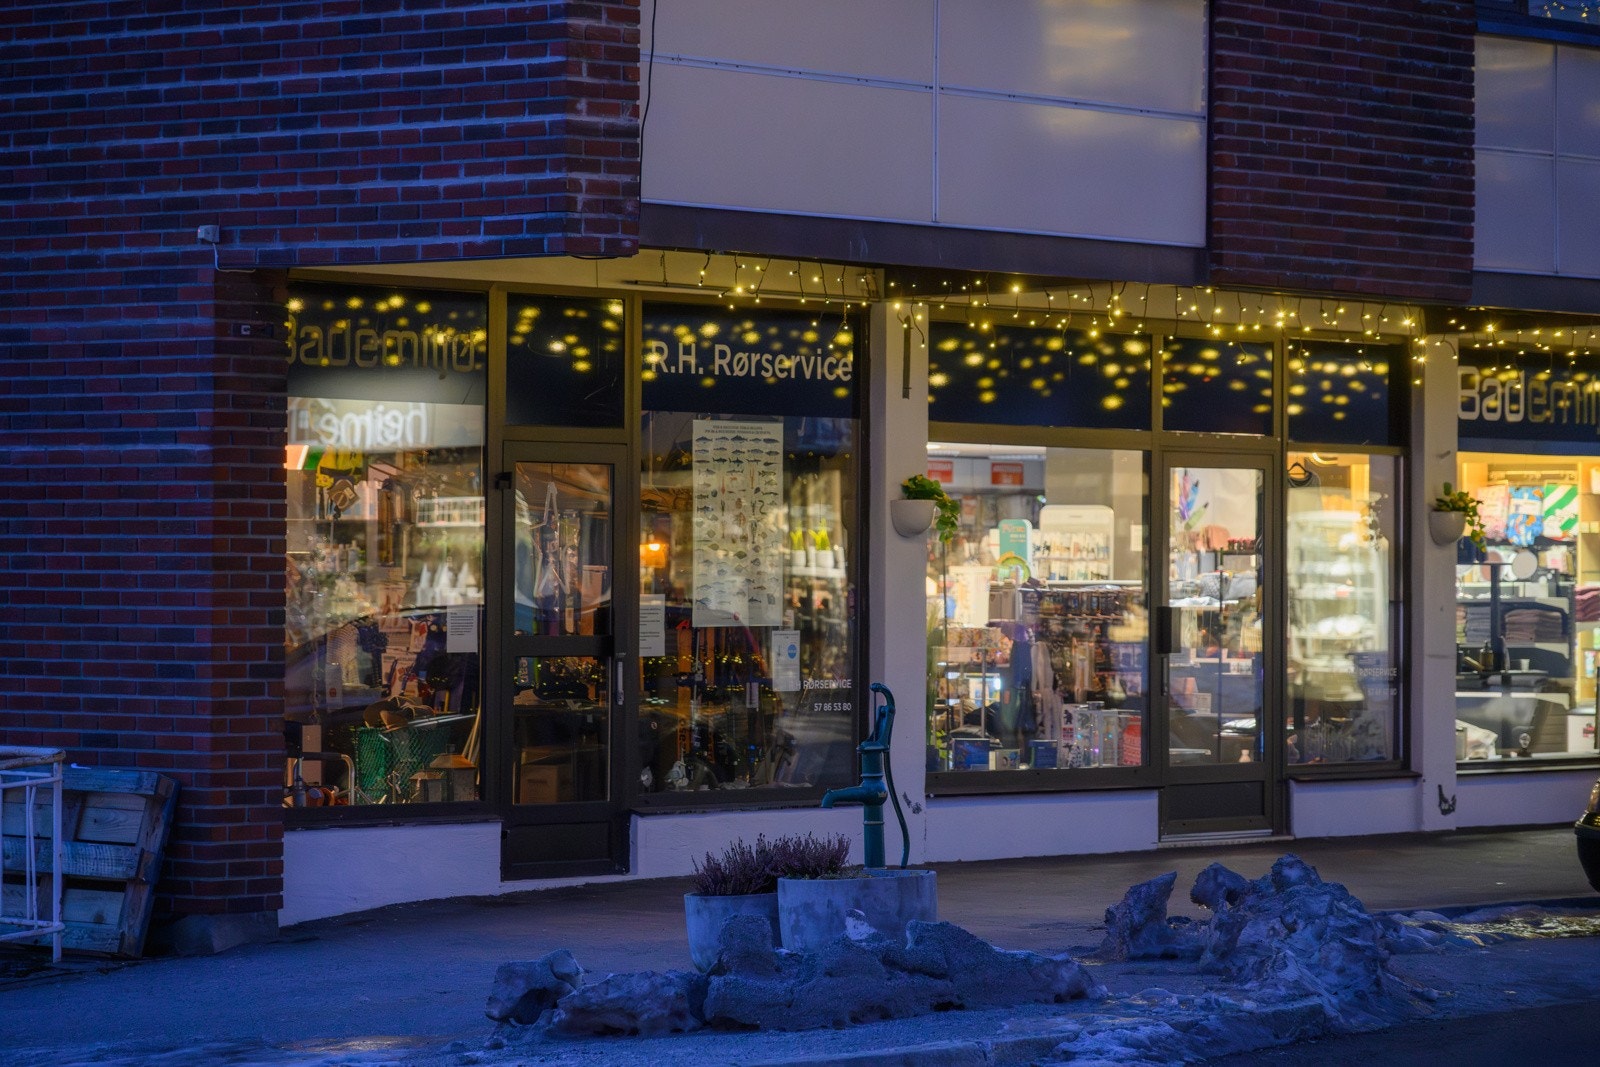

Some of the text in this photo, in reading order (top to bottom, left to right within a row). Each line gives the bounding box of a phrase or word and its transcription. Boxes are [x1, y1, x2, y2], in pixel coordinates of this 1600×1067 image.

[651, 340, 853, 382] R.H. Rørservice
[803, 679, 853, 690] RØRSERVICE
[814, 703, 822, 711] 57
[842, 703, 852, 711] 80
